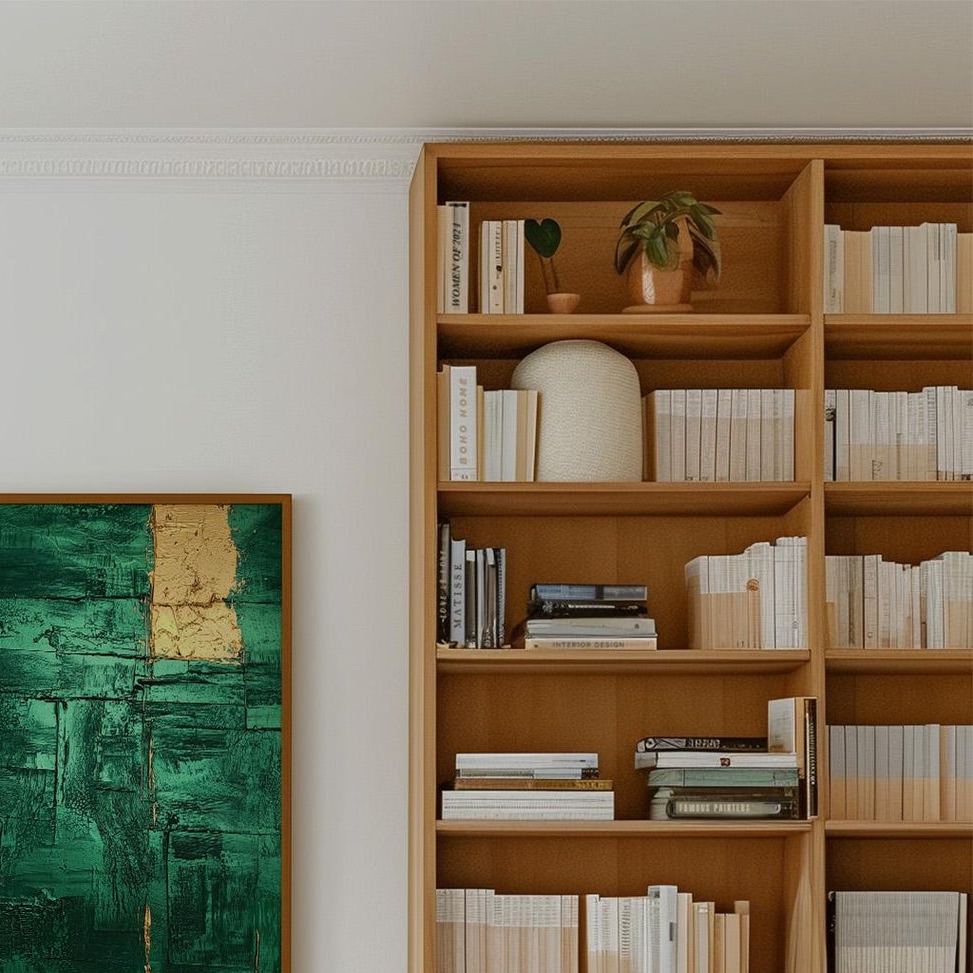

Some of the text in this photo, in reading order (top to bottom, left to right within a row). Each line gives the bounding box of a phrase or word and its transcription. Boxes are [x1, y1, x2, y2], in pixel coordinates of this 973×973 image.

[452, 247, 461, 262] OF
[451, 263, 461, 307] WOMEN
[459, 377, 468, 418] HOME
[453, 563, 463, 629] MATISSE
[679, 803, 750, 812] FAMOUS PAINTERS
